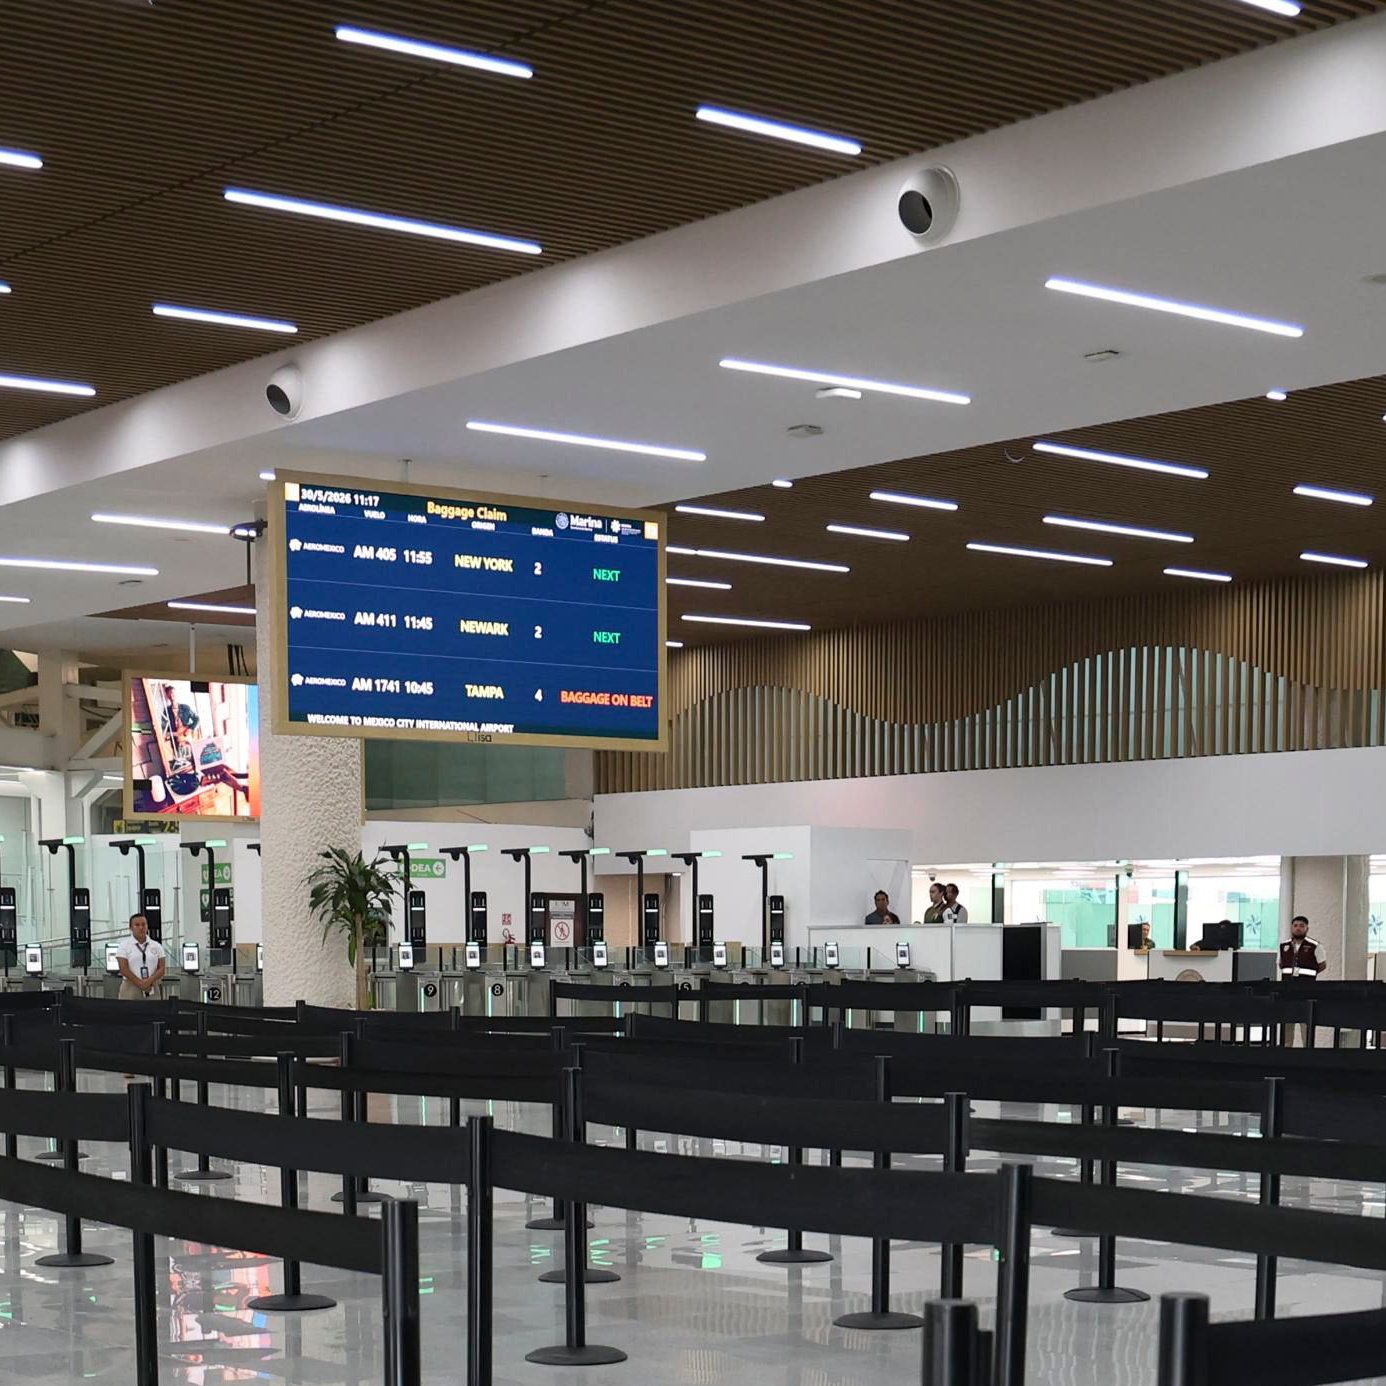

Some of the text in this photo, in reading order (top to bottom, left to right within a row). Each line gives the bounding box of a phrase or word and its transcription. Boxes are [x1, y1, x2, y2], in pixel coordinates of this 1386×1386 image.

[301, 488, 380, 507] 30/5/2026 11:17
[427, 501, 507, 521] Baggage Claim
[363, 509, 386, 520] VUELO
[407, 513, 427, 524] HORA
[471, 520, 496, 531] ORIGEN
[531, 526, 554, 537] BANDA
[570, 514, 603, 529] Marina
[303, 541, 621, 582] AEROMEXICO AM 405 11:55 NEW YORK 2 NEXT
[304, 609, 621, 644] AEROMEXICO AM 411 11:45 NEWARK 2 NEXT
[305, 676, 653, 708] AEROMEXICO AM 1741 10:45 TAMPA 4 BAGGAGE ON BELT
[307, 713, 514, 733] WELCOME TO MEXICO CITY INTERNATIONAL AIRPORT
[478, 733, 492, 743] isa
[413, 863, 431, 873] DEA
[209, 989, 220, 999] 12
[427, 985, 435, 995] 9
[494, 984, 502, 995] 8
